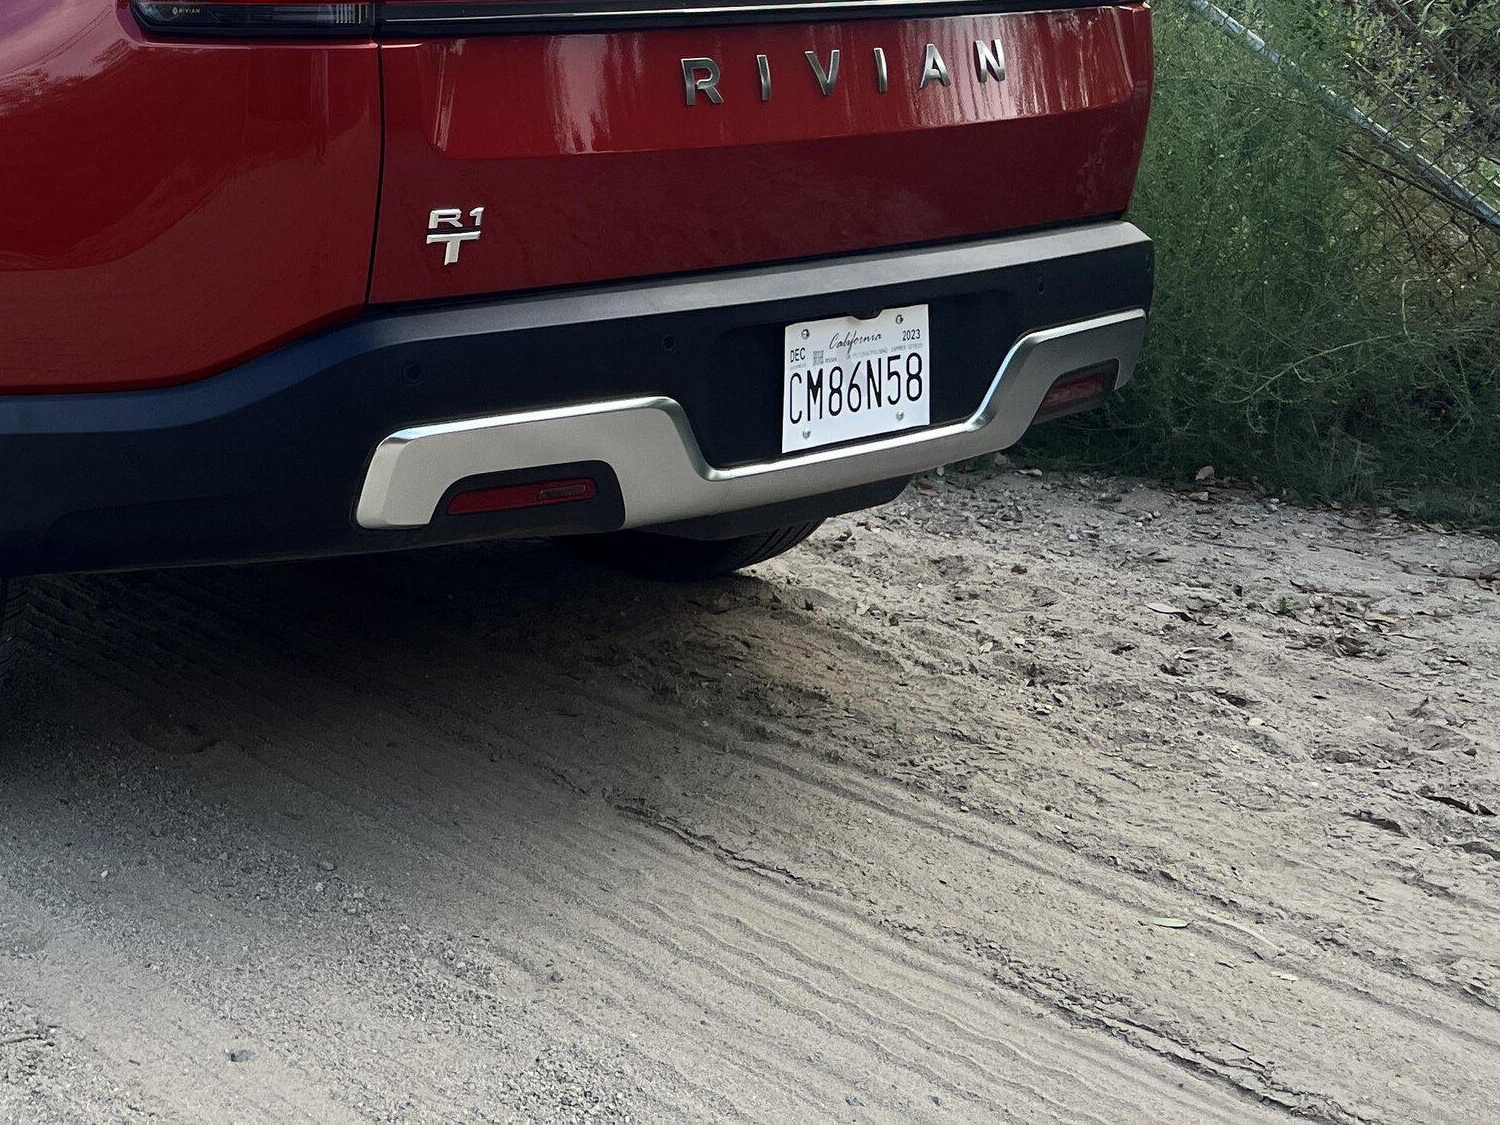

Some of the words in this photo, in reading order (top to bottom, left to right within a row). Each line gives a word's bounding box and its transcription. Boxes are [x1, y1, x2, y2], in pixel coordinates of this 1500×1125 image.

[681, 39, 1006, 106] RIVIAN
[829, 331, 882, 354] California
[902, 328, 921, 342] 2023
[790, 347, 806, 362] DEC
[789, 352, 923, 424] CM86N58
